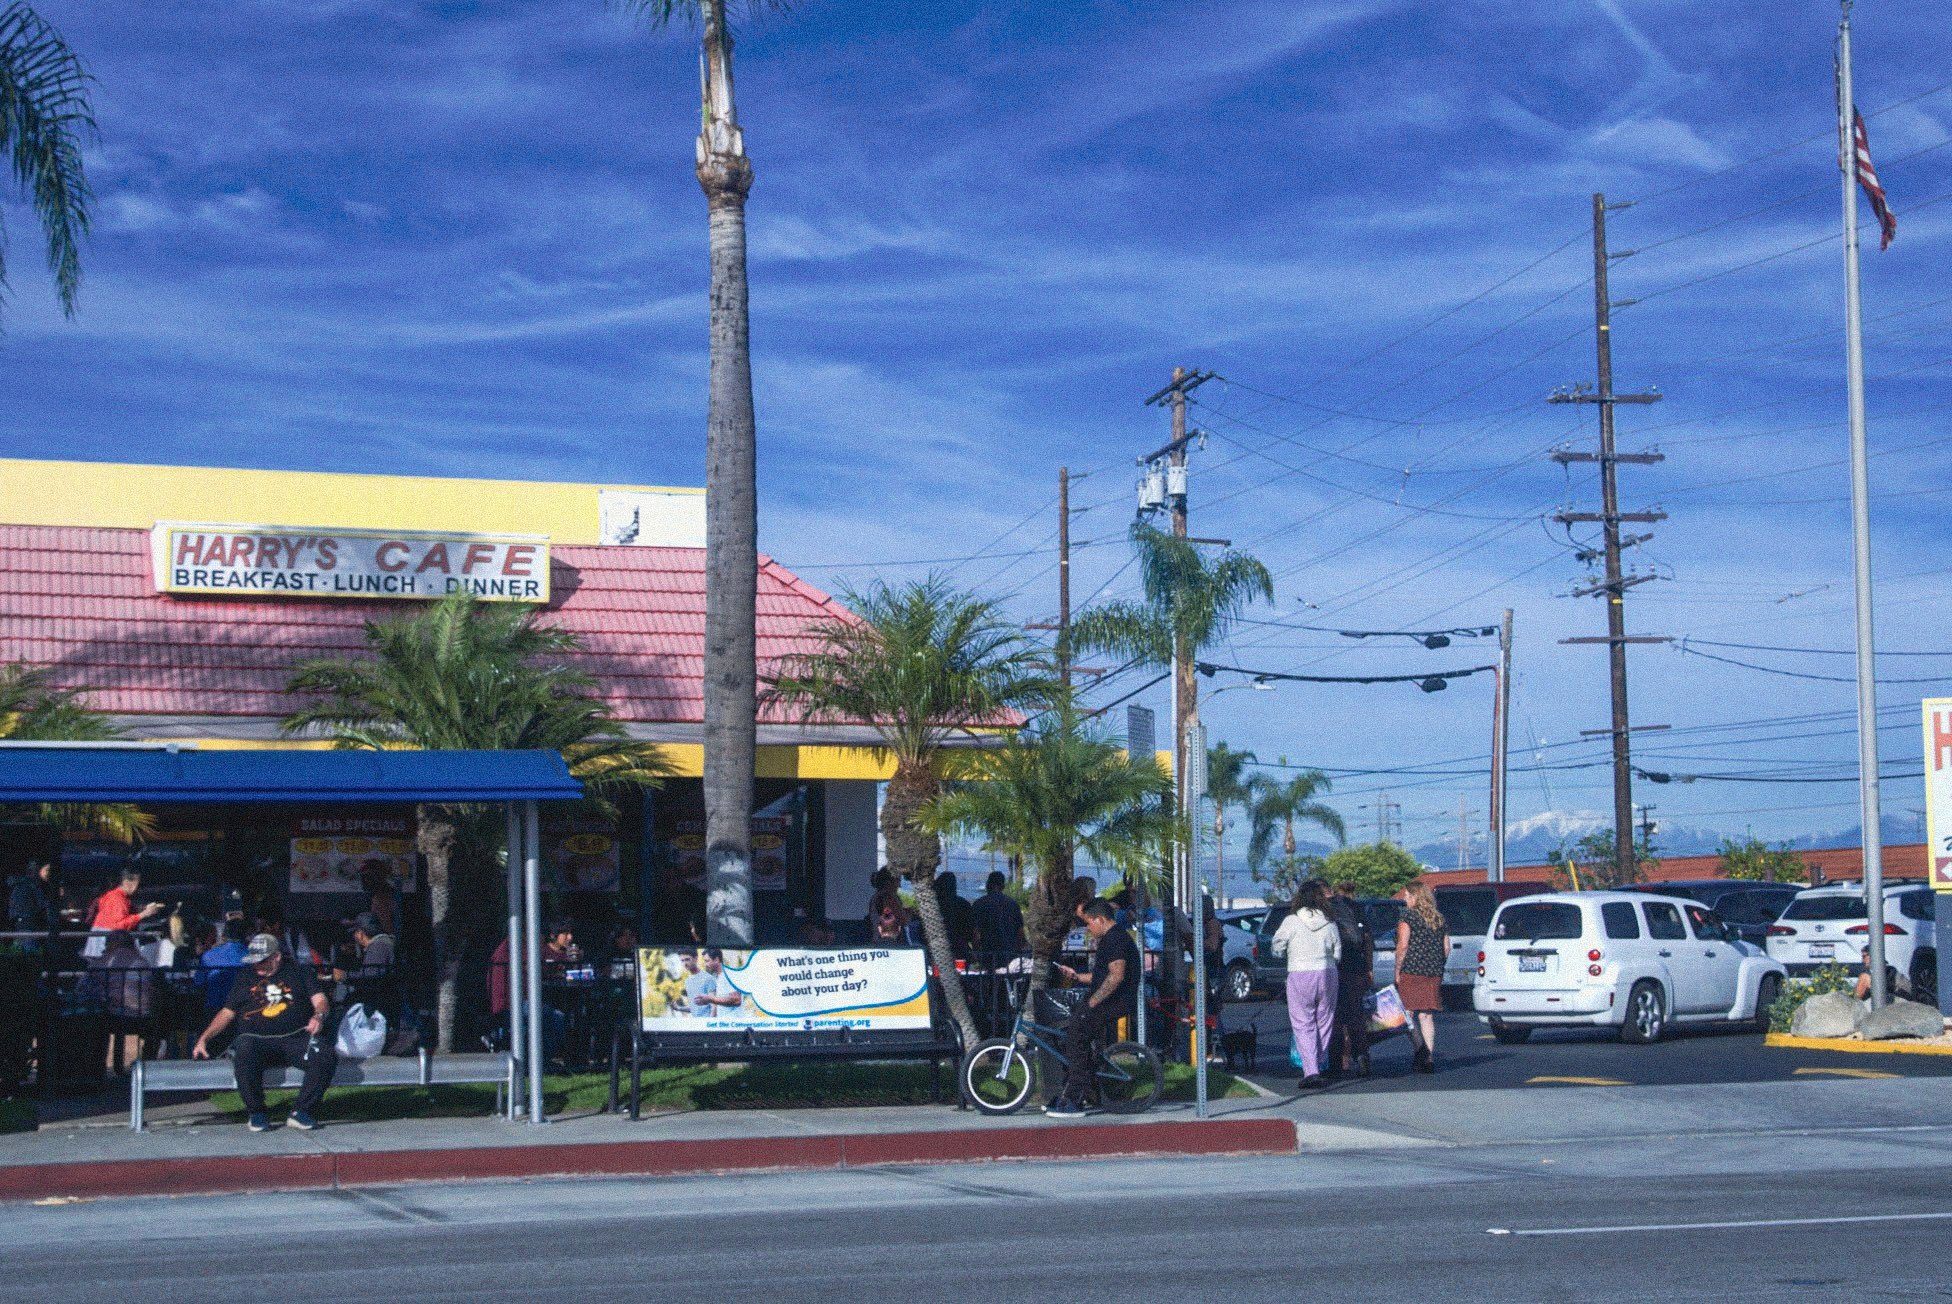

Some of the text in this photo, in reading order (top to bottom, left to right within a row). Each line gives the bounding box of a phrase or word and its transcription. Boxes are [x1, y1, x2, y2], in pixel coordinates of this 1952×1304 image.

[175, 534, 537, 576] HARRY'S CAFE
[174, 568, 539, 598] BREAKFAST LUNCH DINNER
[776, 950, 889, 967] What's one thing you
[779, 968, 854, 982] would change
[781, 979, 868, 997] about your day?
